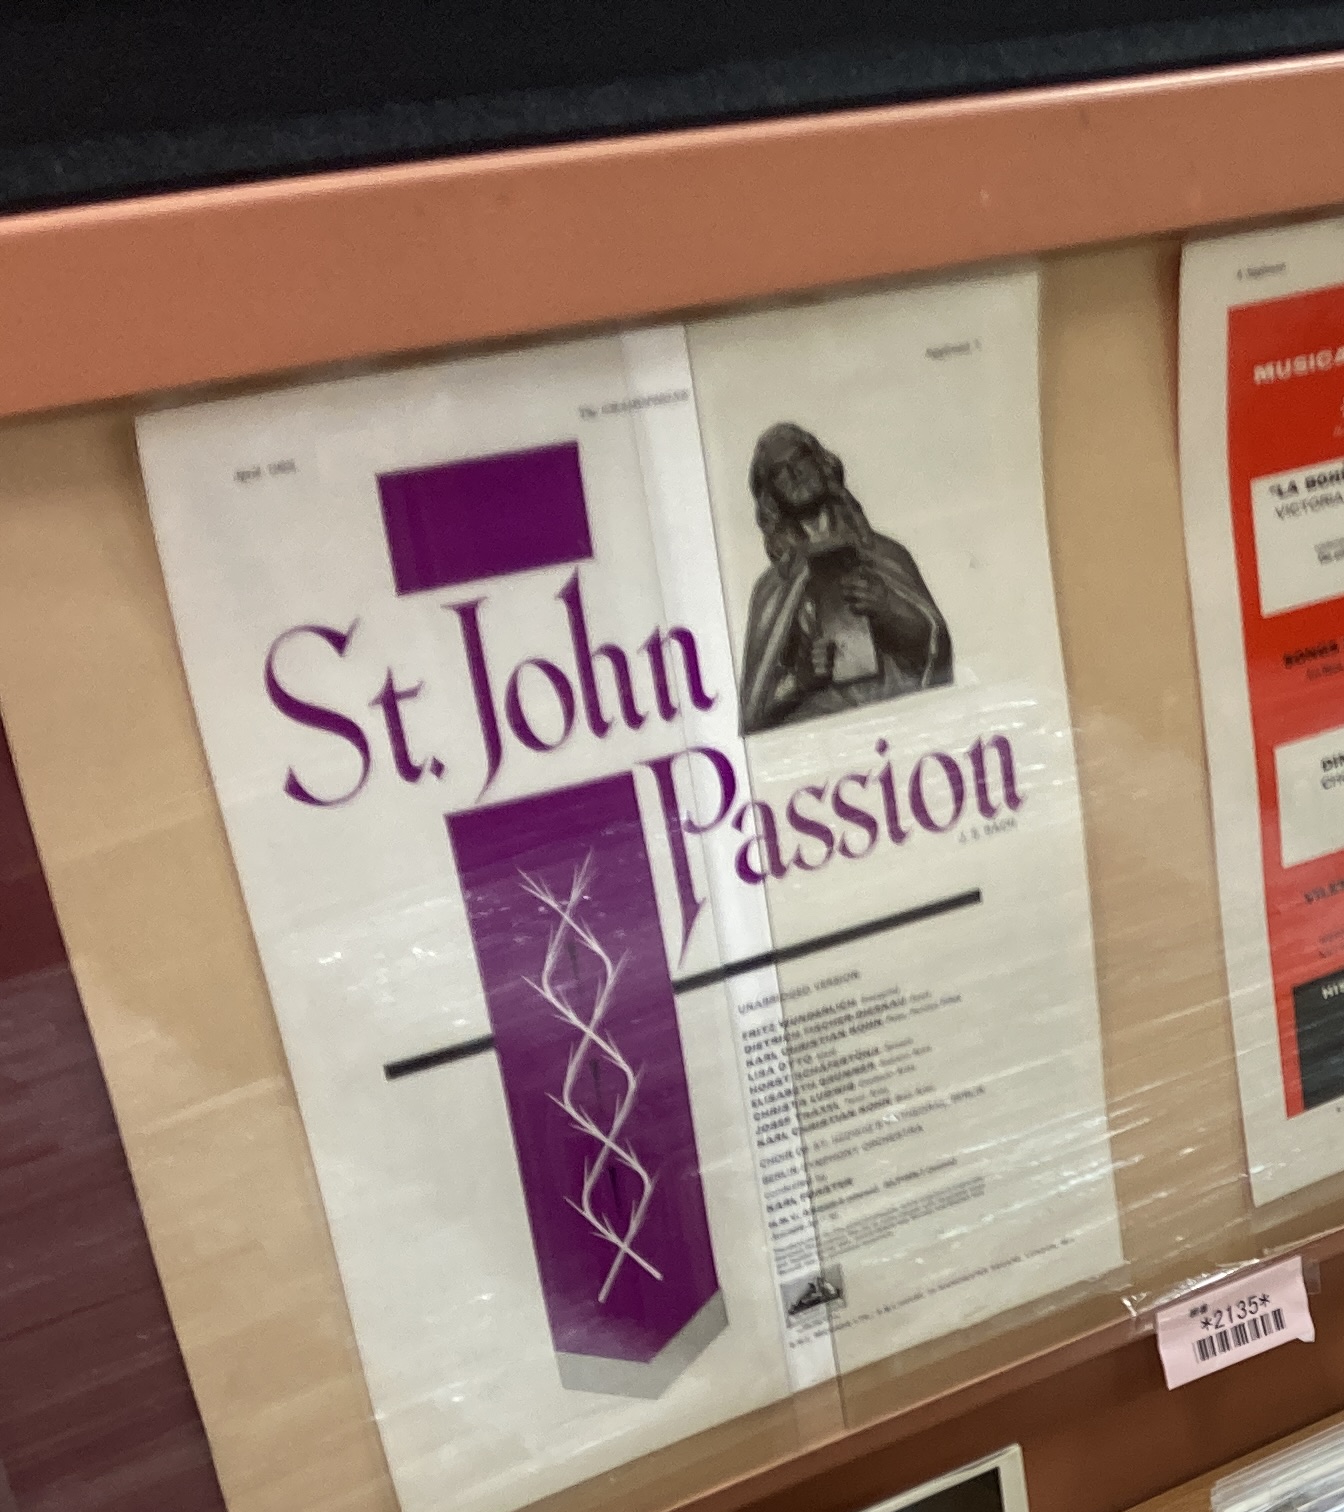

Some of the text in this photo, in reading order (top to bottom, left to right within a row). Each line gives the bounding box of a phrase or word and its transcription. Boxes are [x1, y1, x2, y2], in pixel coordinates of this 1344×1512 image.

[263, 566, 719, 808] St. John
[637, 729, 1026, 967] Passion
